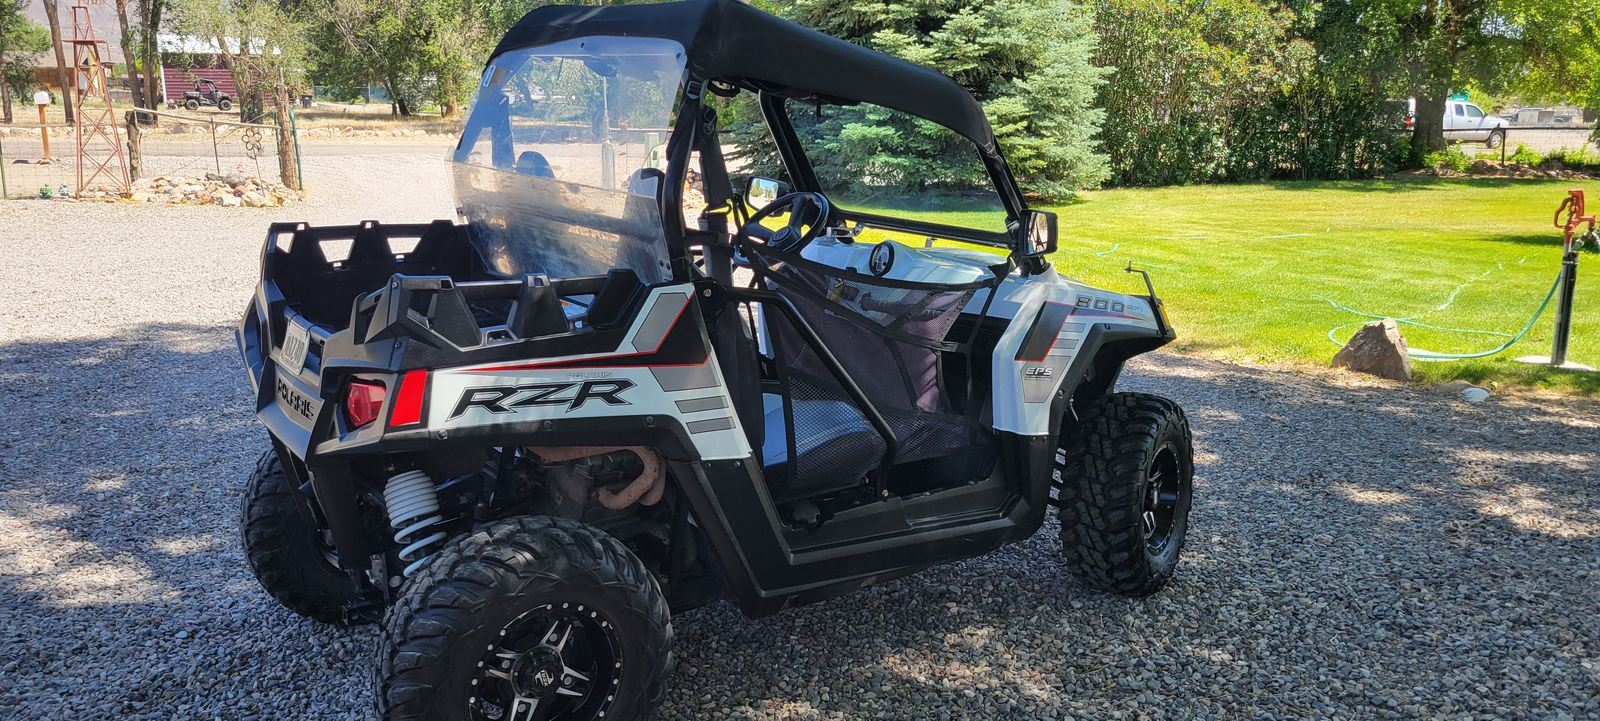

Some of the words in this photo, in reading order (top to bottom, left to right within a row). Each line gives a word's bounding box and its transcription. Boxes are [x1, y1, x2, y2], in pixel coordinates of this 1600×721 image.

[1075, 294, 1125, 313] 800
[1026, 367, 1053, 376] EPS
[277, 378, 315, 421] POLARIS
[445, 378, 637, 422] RZR
